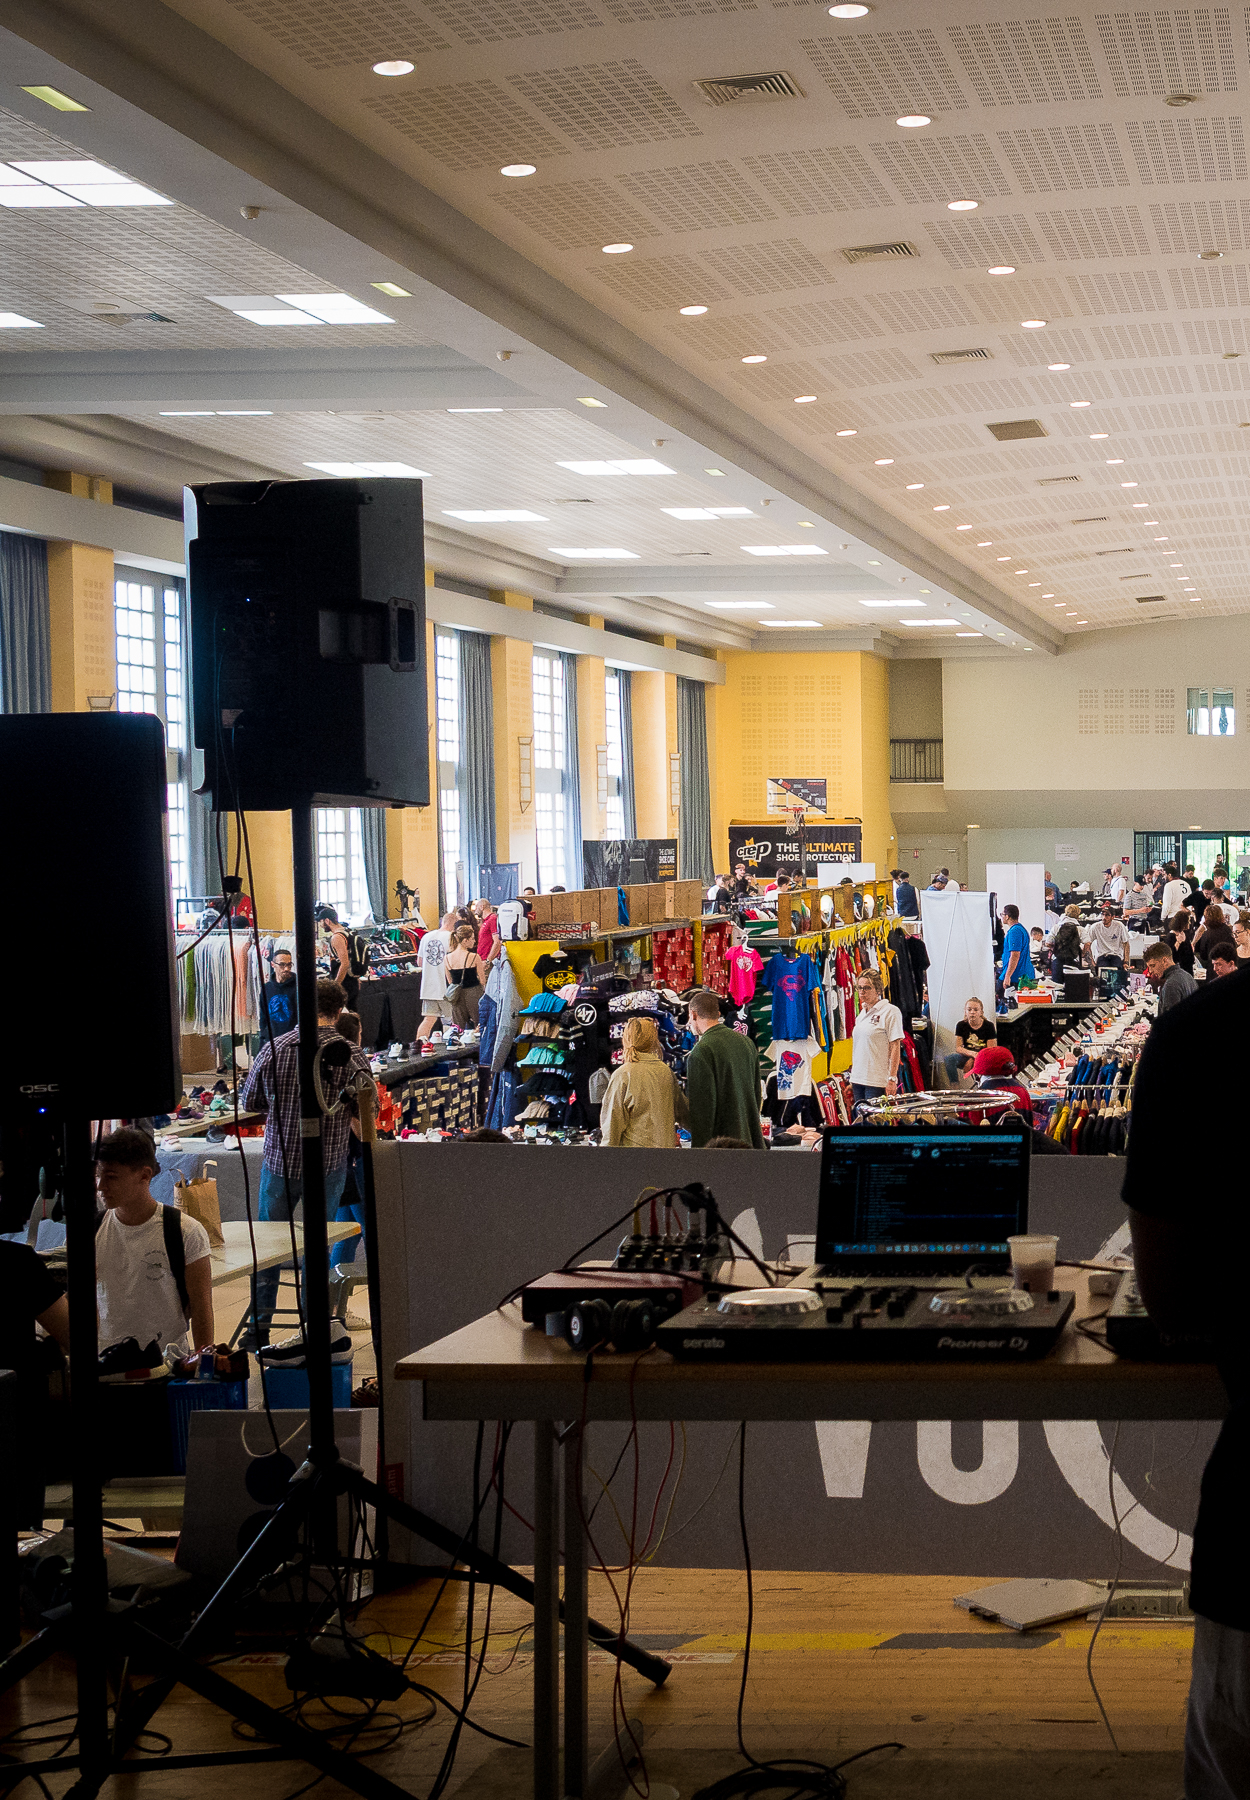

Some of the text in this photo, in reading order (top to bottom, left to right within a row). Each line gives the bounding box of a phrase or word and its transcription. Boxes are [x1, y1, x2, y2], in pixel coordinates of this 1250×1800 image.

[776, 843, 799, 852] THE
[1179, 883, 1188, 894] 3
[18, 1083, 61, 1094] QSC
[682, 1336, 726, 1349] serato
[936, 1336, 1007, 1350] Pioneer
[240, 1656, 280, 1664] NE
